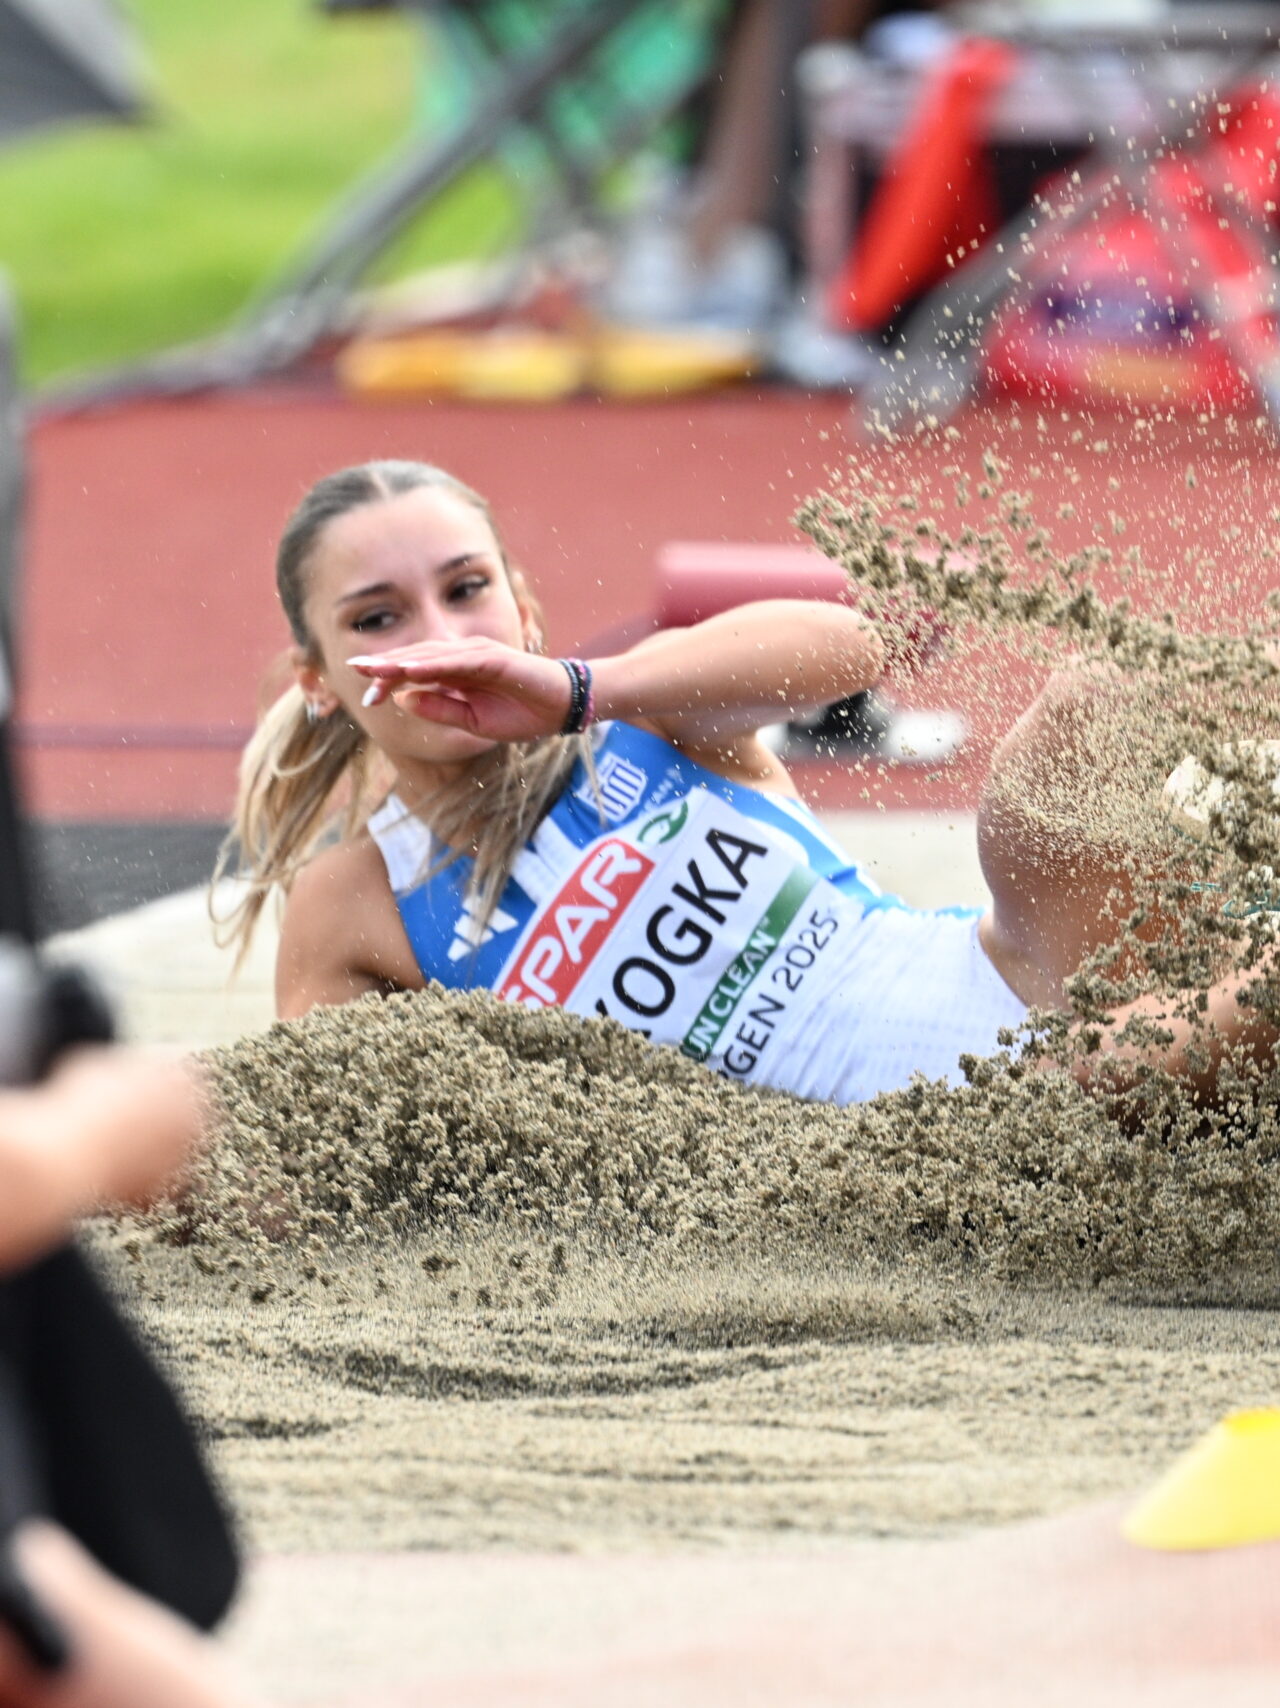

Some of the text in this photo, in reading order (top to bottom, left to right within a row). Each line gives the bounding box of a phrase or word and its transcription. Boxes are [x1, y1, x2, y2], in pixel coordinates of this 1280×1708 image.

[595, 828, 768, 1039] OGKA
[716, 909, 838, 1080] GEN 2025
